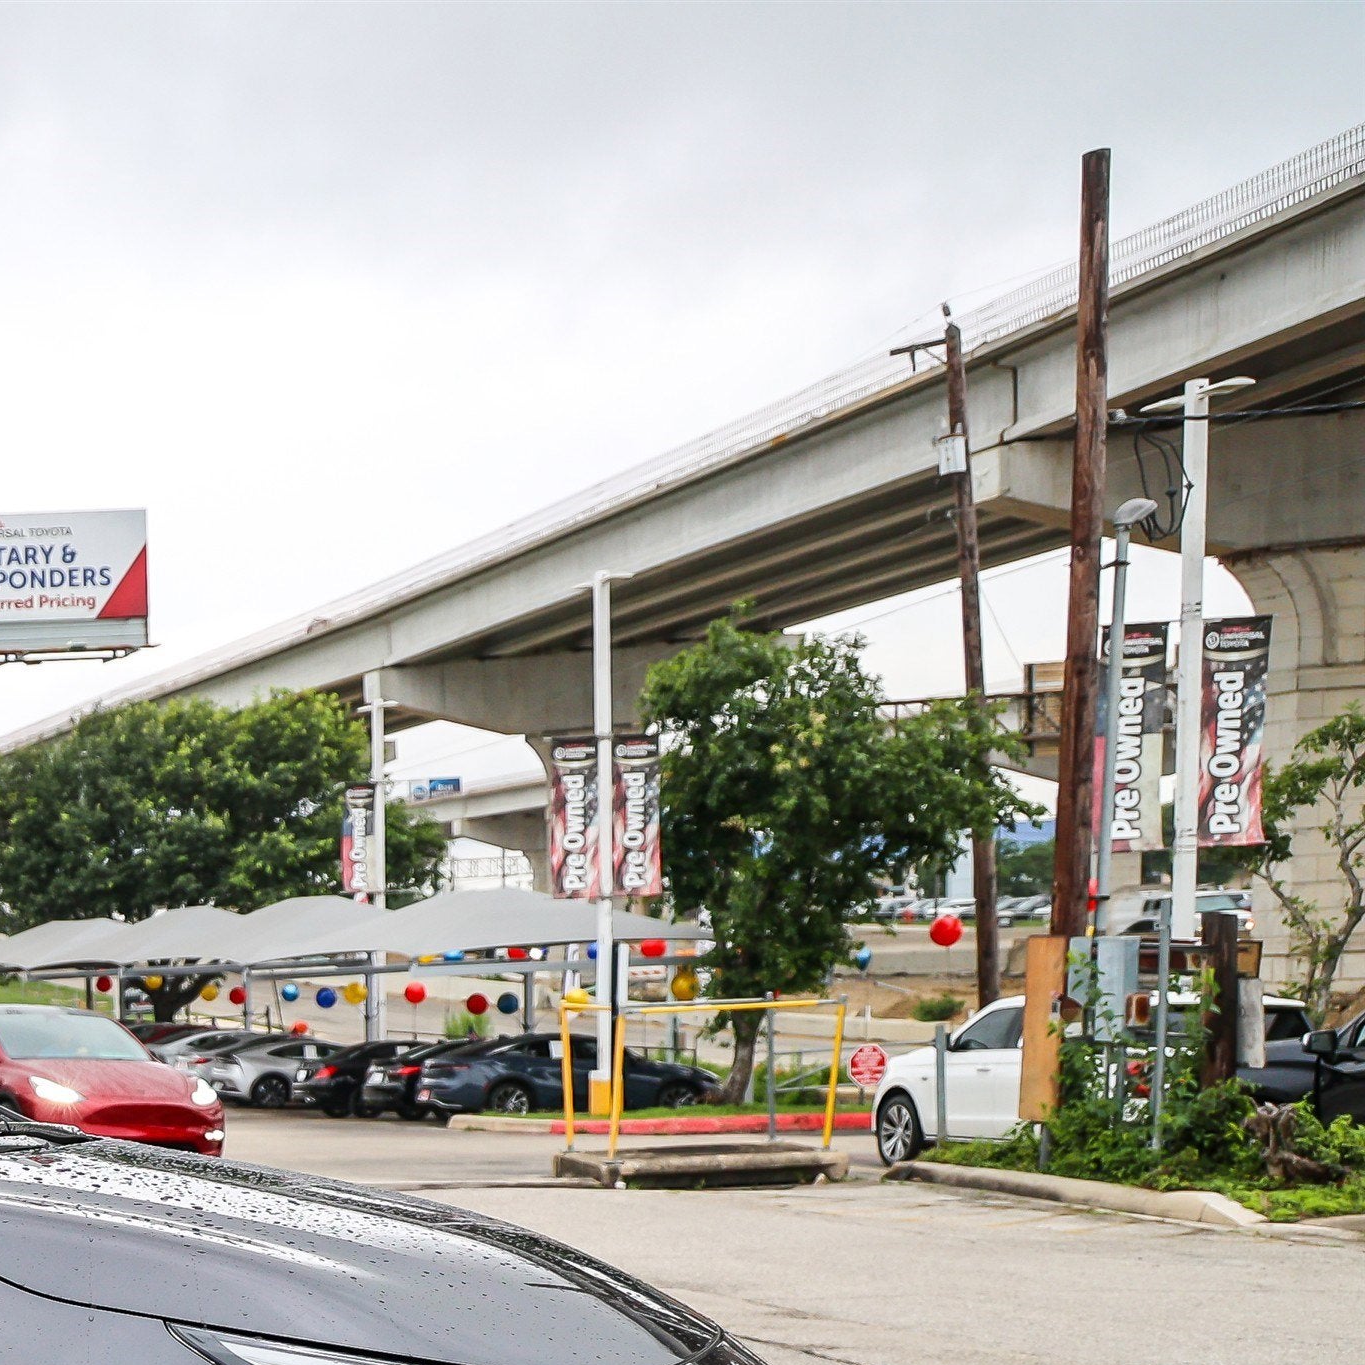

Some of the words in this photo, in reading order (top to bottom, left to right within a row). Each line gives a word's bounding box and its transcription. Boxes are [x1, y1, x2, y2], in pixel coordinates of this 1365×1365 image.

[29, 526, 73, 537] TOYOTA
[61, 543, 77, 564] &
[39, 593, 96, 610] Pricing
[1207, 671, 1245, 778] Owned
[561, 774, 586, 852] Owned
[622, 771, 646, 849] Owned
[1111, 790, 1142, 841] Pre
[1208, 783, 1241, 835] Pre
[563, 853, 587, 892] Pre
[622, 850, 647, 889] Pre
